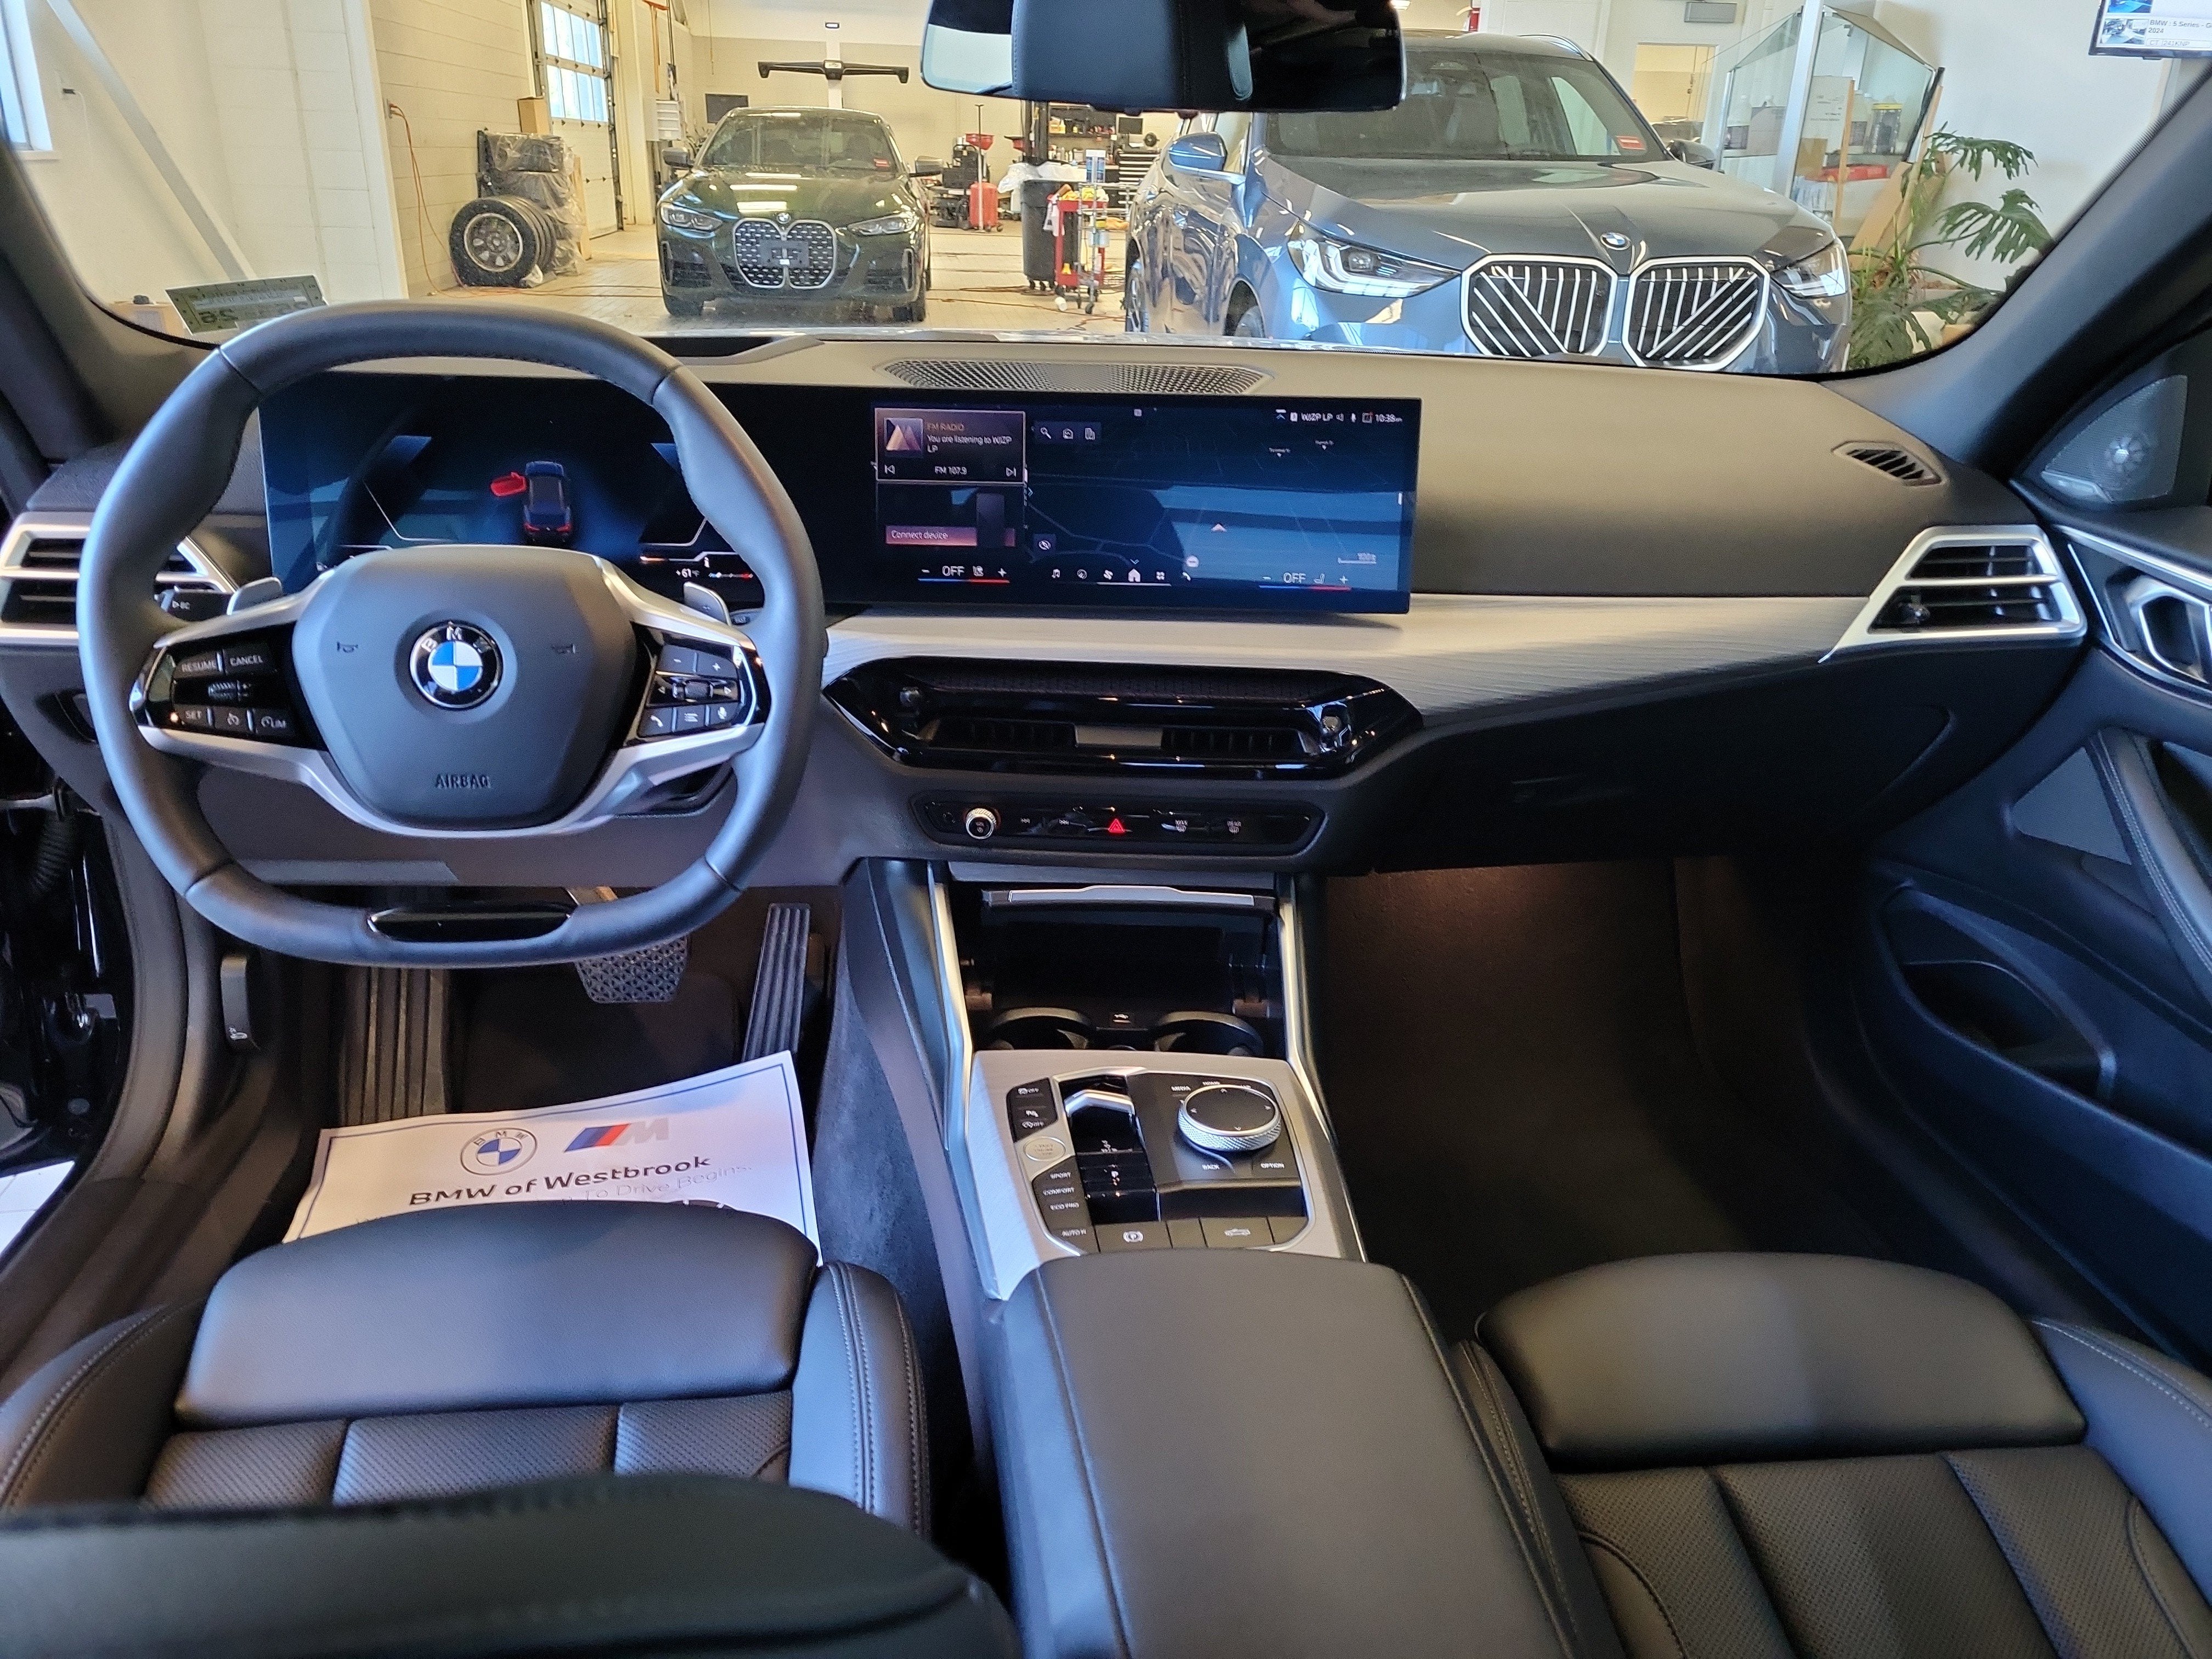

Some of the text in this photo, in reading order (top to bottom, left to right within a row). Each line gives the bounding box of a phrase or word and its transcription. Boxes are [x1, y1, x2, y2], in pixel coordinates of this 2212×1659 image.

[927, 435, 941, 443] You
[954, 435, 983, 445] listening
[928, 445, 938, 453] LP
[935, 466, 967, 475] FM 107.9
[891, 530, 949, 540] Connect device
[942, 565, 964, 576] OFF
[1283, 572, 1307, 584] OFF
[182, 659, 216, 673] RESUME
[229, 654, 263, 667] CANCEL
[185, 710, 201, 720] SET
[435, 774, 491, 789] AIRBAG
[410, 1156, 711, 1205] BMW of Westbrook
[616, 1182, 670, 1197] Drive
